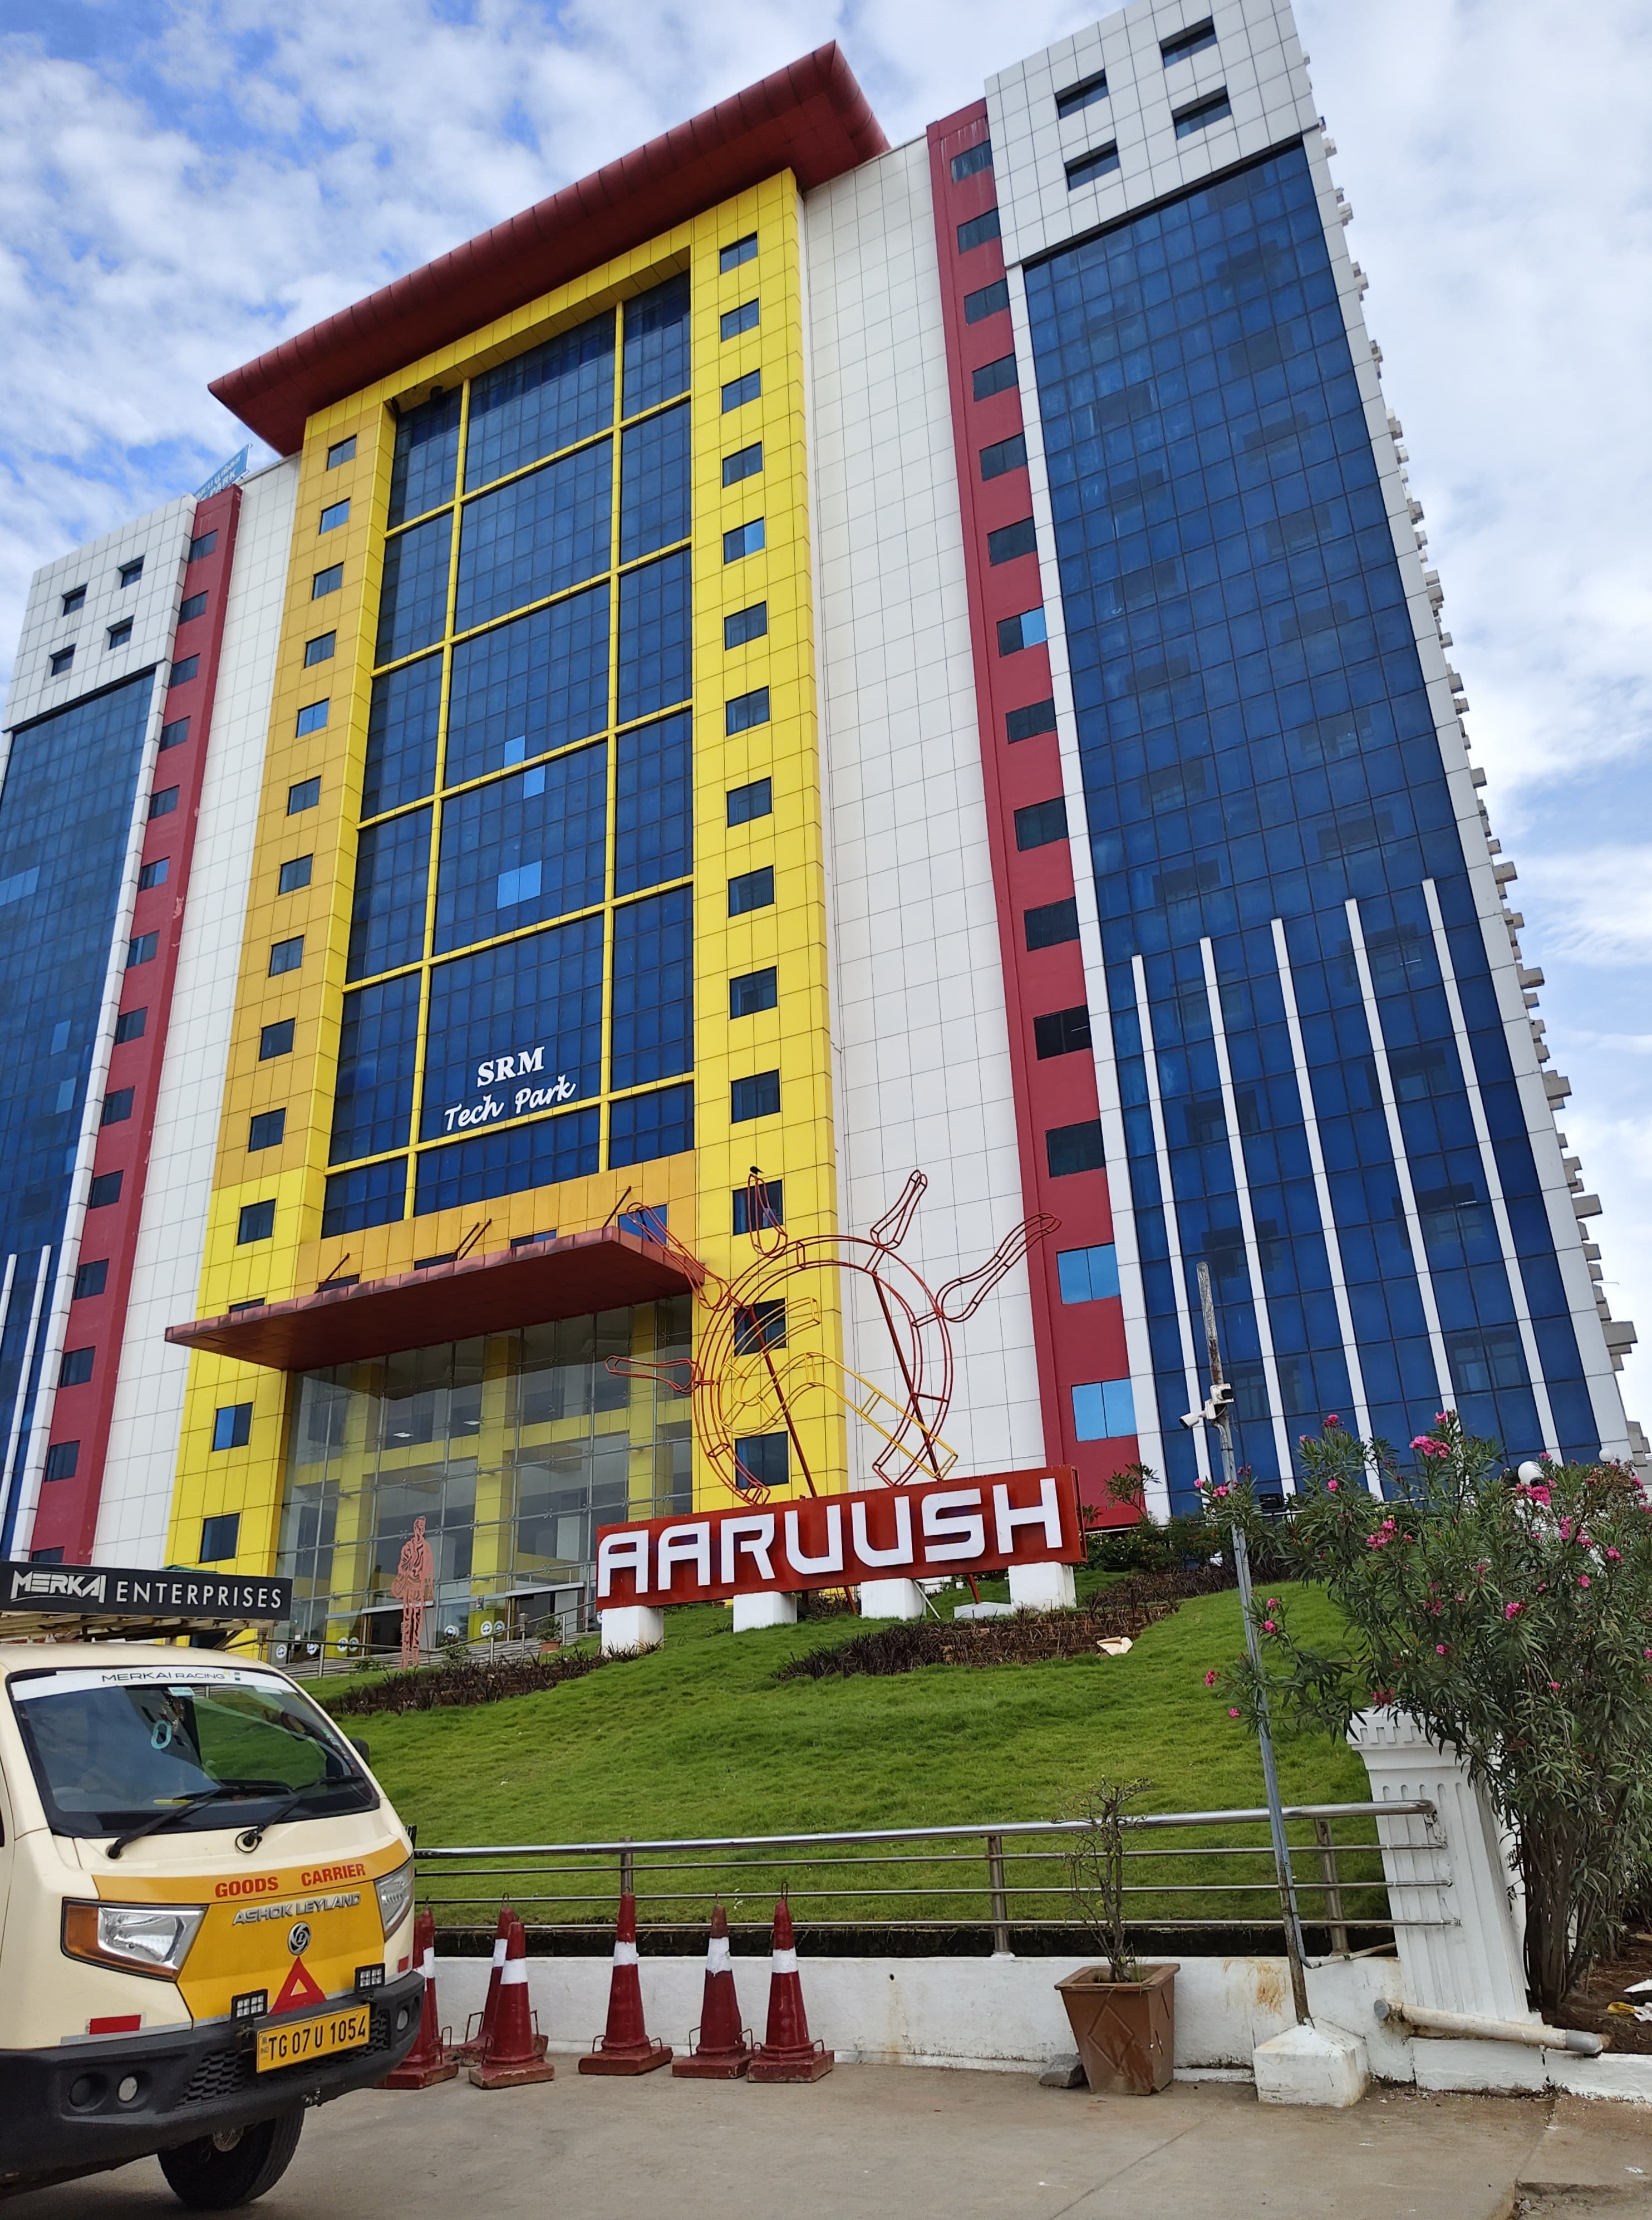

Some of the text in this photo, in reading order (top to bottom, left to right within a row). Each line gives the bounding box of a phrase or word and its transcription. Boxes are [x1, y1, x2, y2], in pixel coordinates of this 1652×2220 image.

[209, 468, 236, 498] PARK
[477, 1046, 545, 1087] SRM
[445, 1074, 576, 1131] Tech Park
[597, 1477, 1063, 1598] AARUUSH
[10, 1569, 282, 1609] MERKAI ENTERPRISES
[102, 1672, 171, 1682] MERKAI
[215, 1863, 366, 1898] GOODS CARRIER
[232, 1893, 361, 1926] ASHOK LEYLAND
